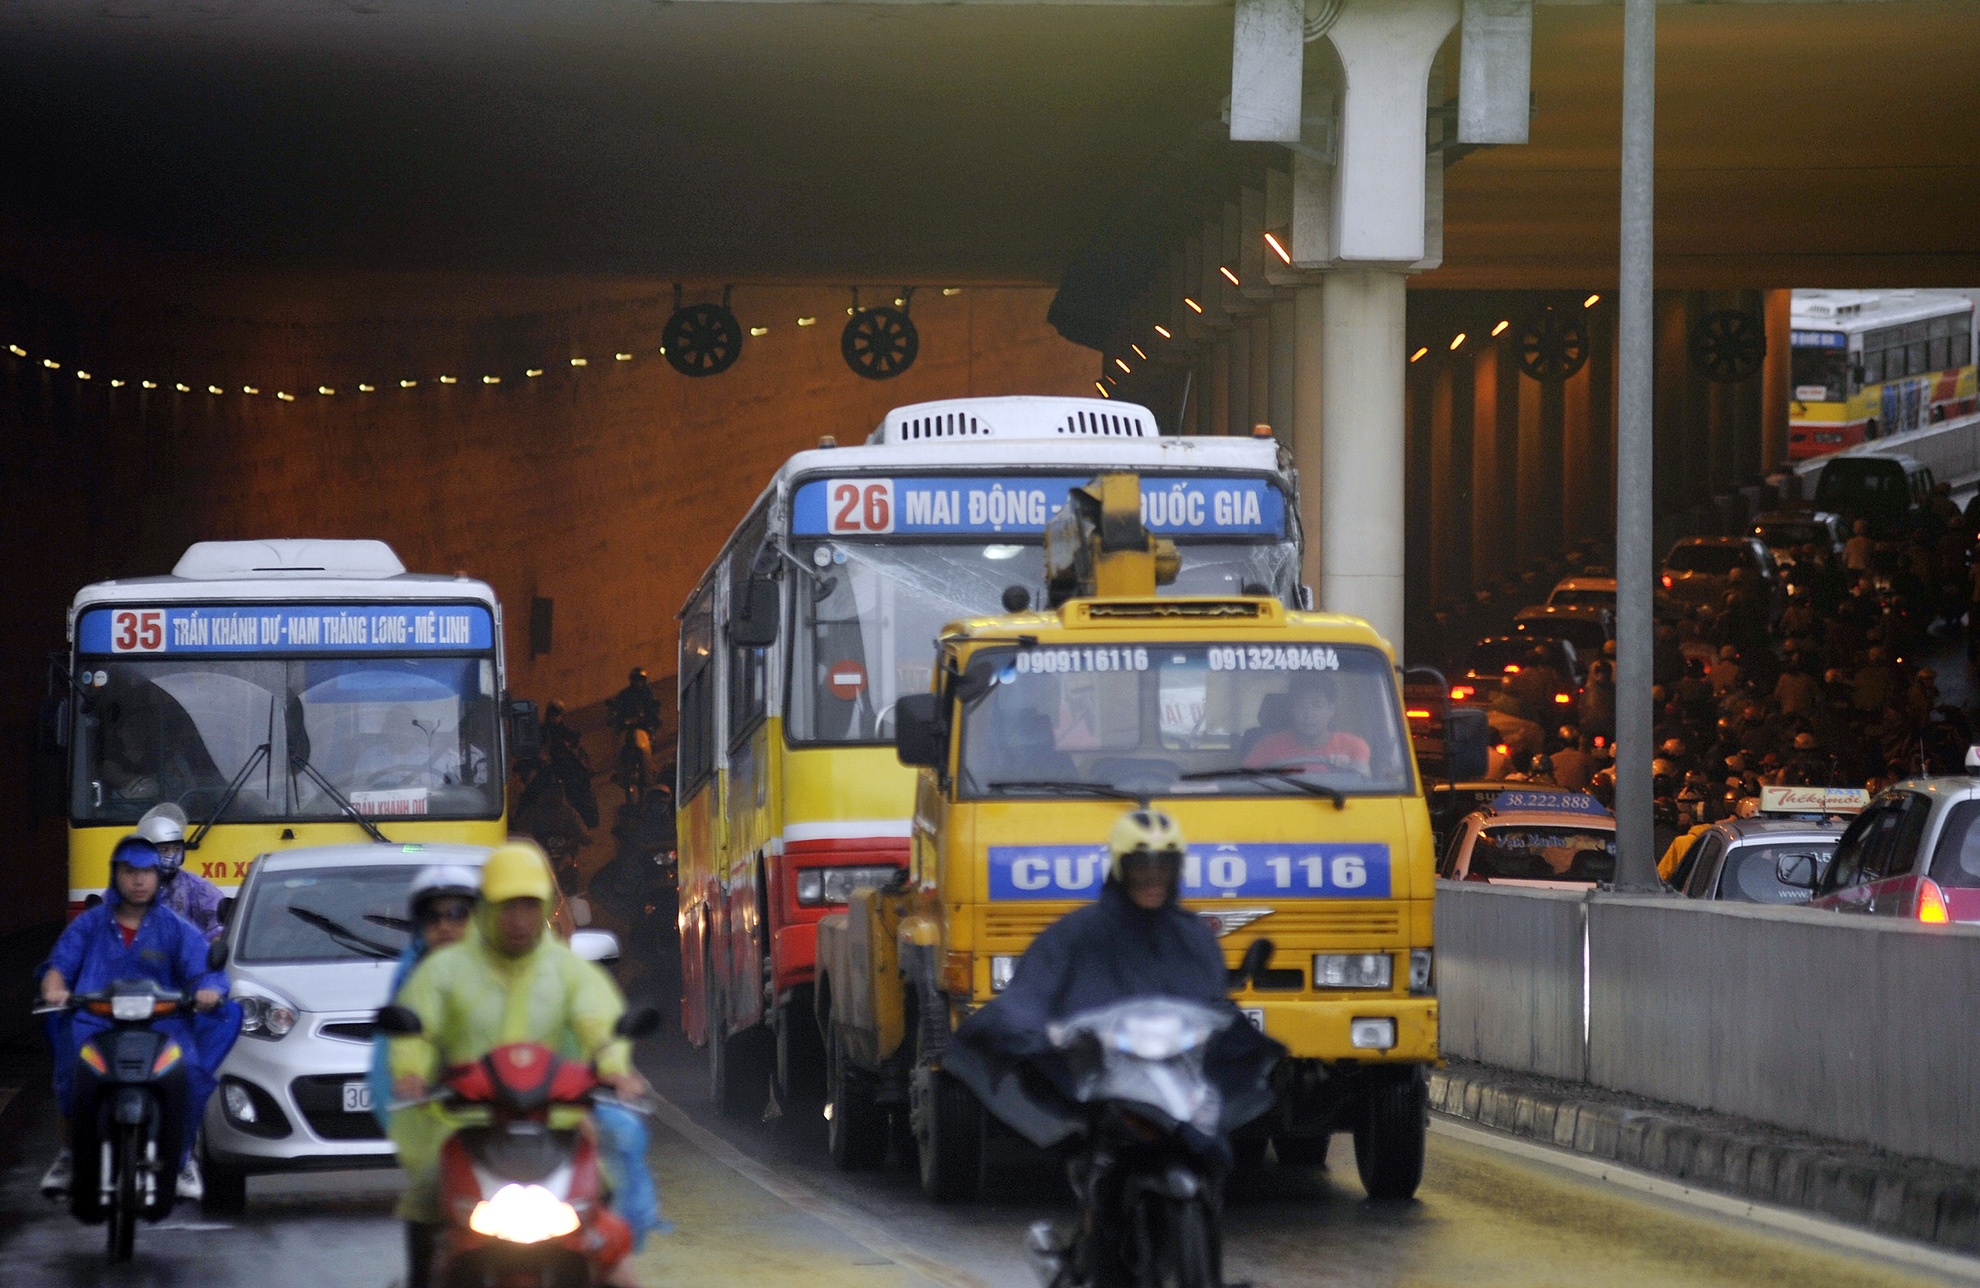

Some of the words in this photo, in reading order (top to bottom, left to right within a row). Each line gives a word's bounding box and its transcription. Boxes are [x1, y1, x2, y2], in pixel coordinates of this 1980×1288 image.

[834, 484, 889, 531] 26
[905, 490, 960, 525] MAI
[1214, 490, 1262, 525] GIA
[116, 612, 162, 650] 35
[173, 610, 208, 646] TRẦN
[212, 612, 257, 646] KHÁNH
[323, 611, 367, 645] THĂNG
[439, 616, 470, 644] LINH
[1016, 649, 1149, 674] 0909116116
[1209, 648, 1340, 671] 0913248464
[1505, 793, 1590, 809] 38.222.888
[1266, 857, 1367, 889] 116
